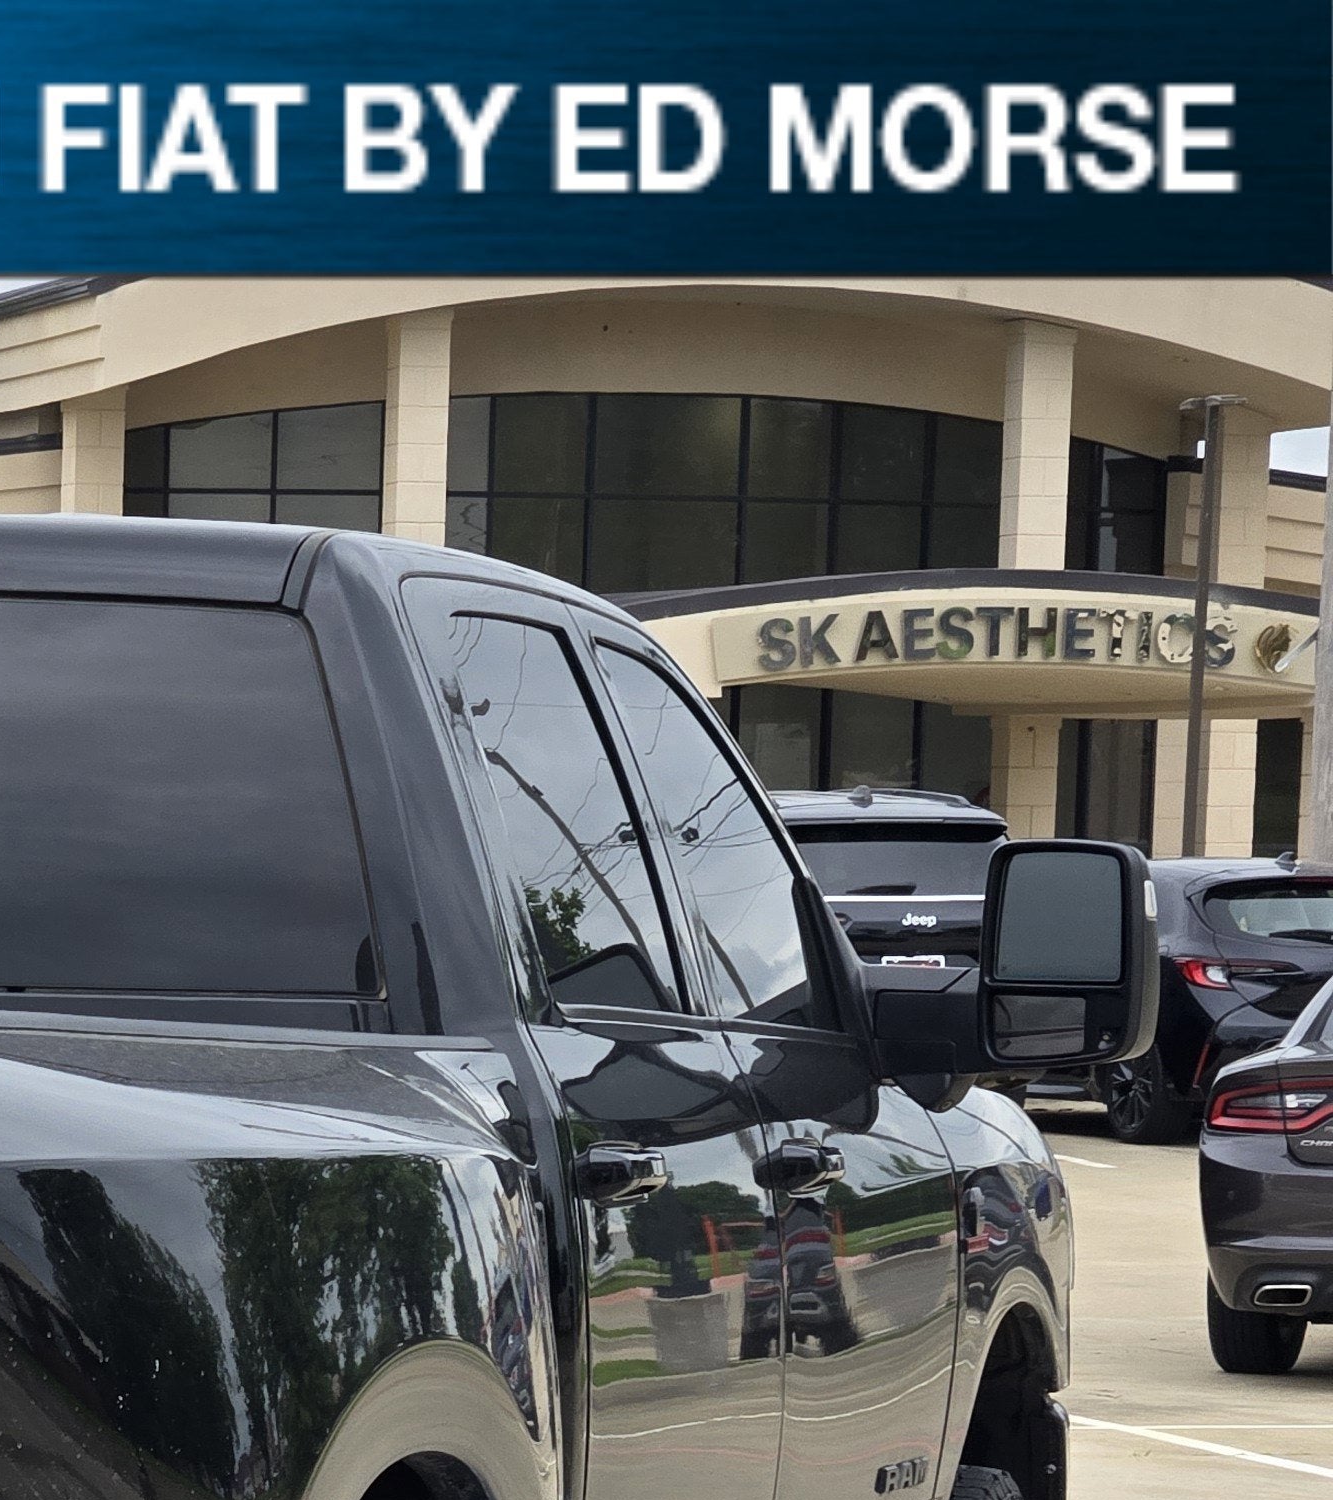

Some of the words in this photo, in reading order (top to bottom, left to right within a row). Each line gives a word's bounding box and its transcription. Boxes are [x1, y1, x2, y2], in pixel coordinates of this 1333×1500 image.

[756, 613, 841, 671] SK
[855, 606, 1237, 668] AESTHETICS
[901, 912, 937, 928] Jeep
[875, 1456, 928, 1494] RAM
